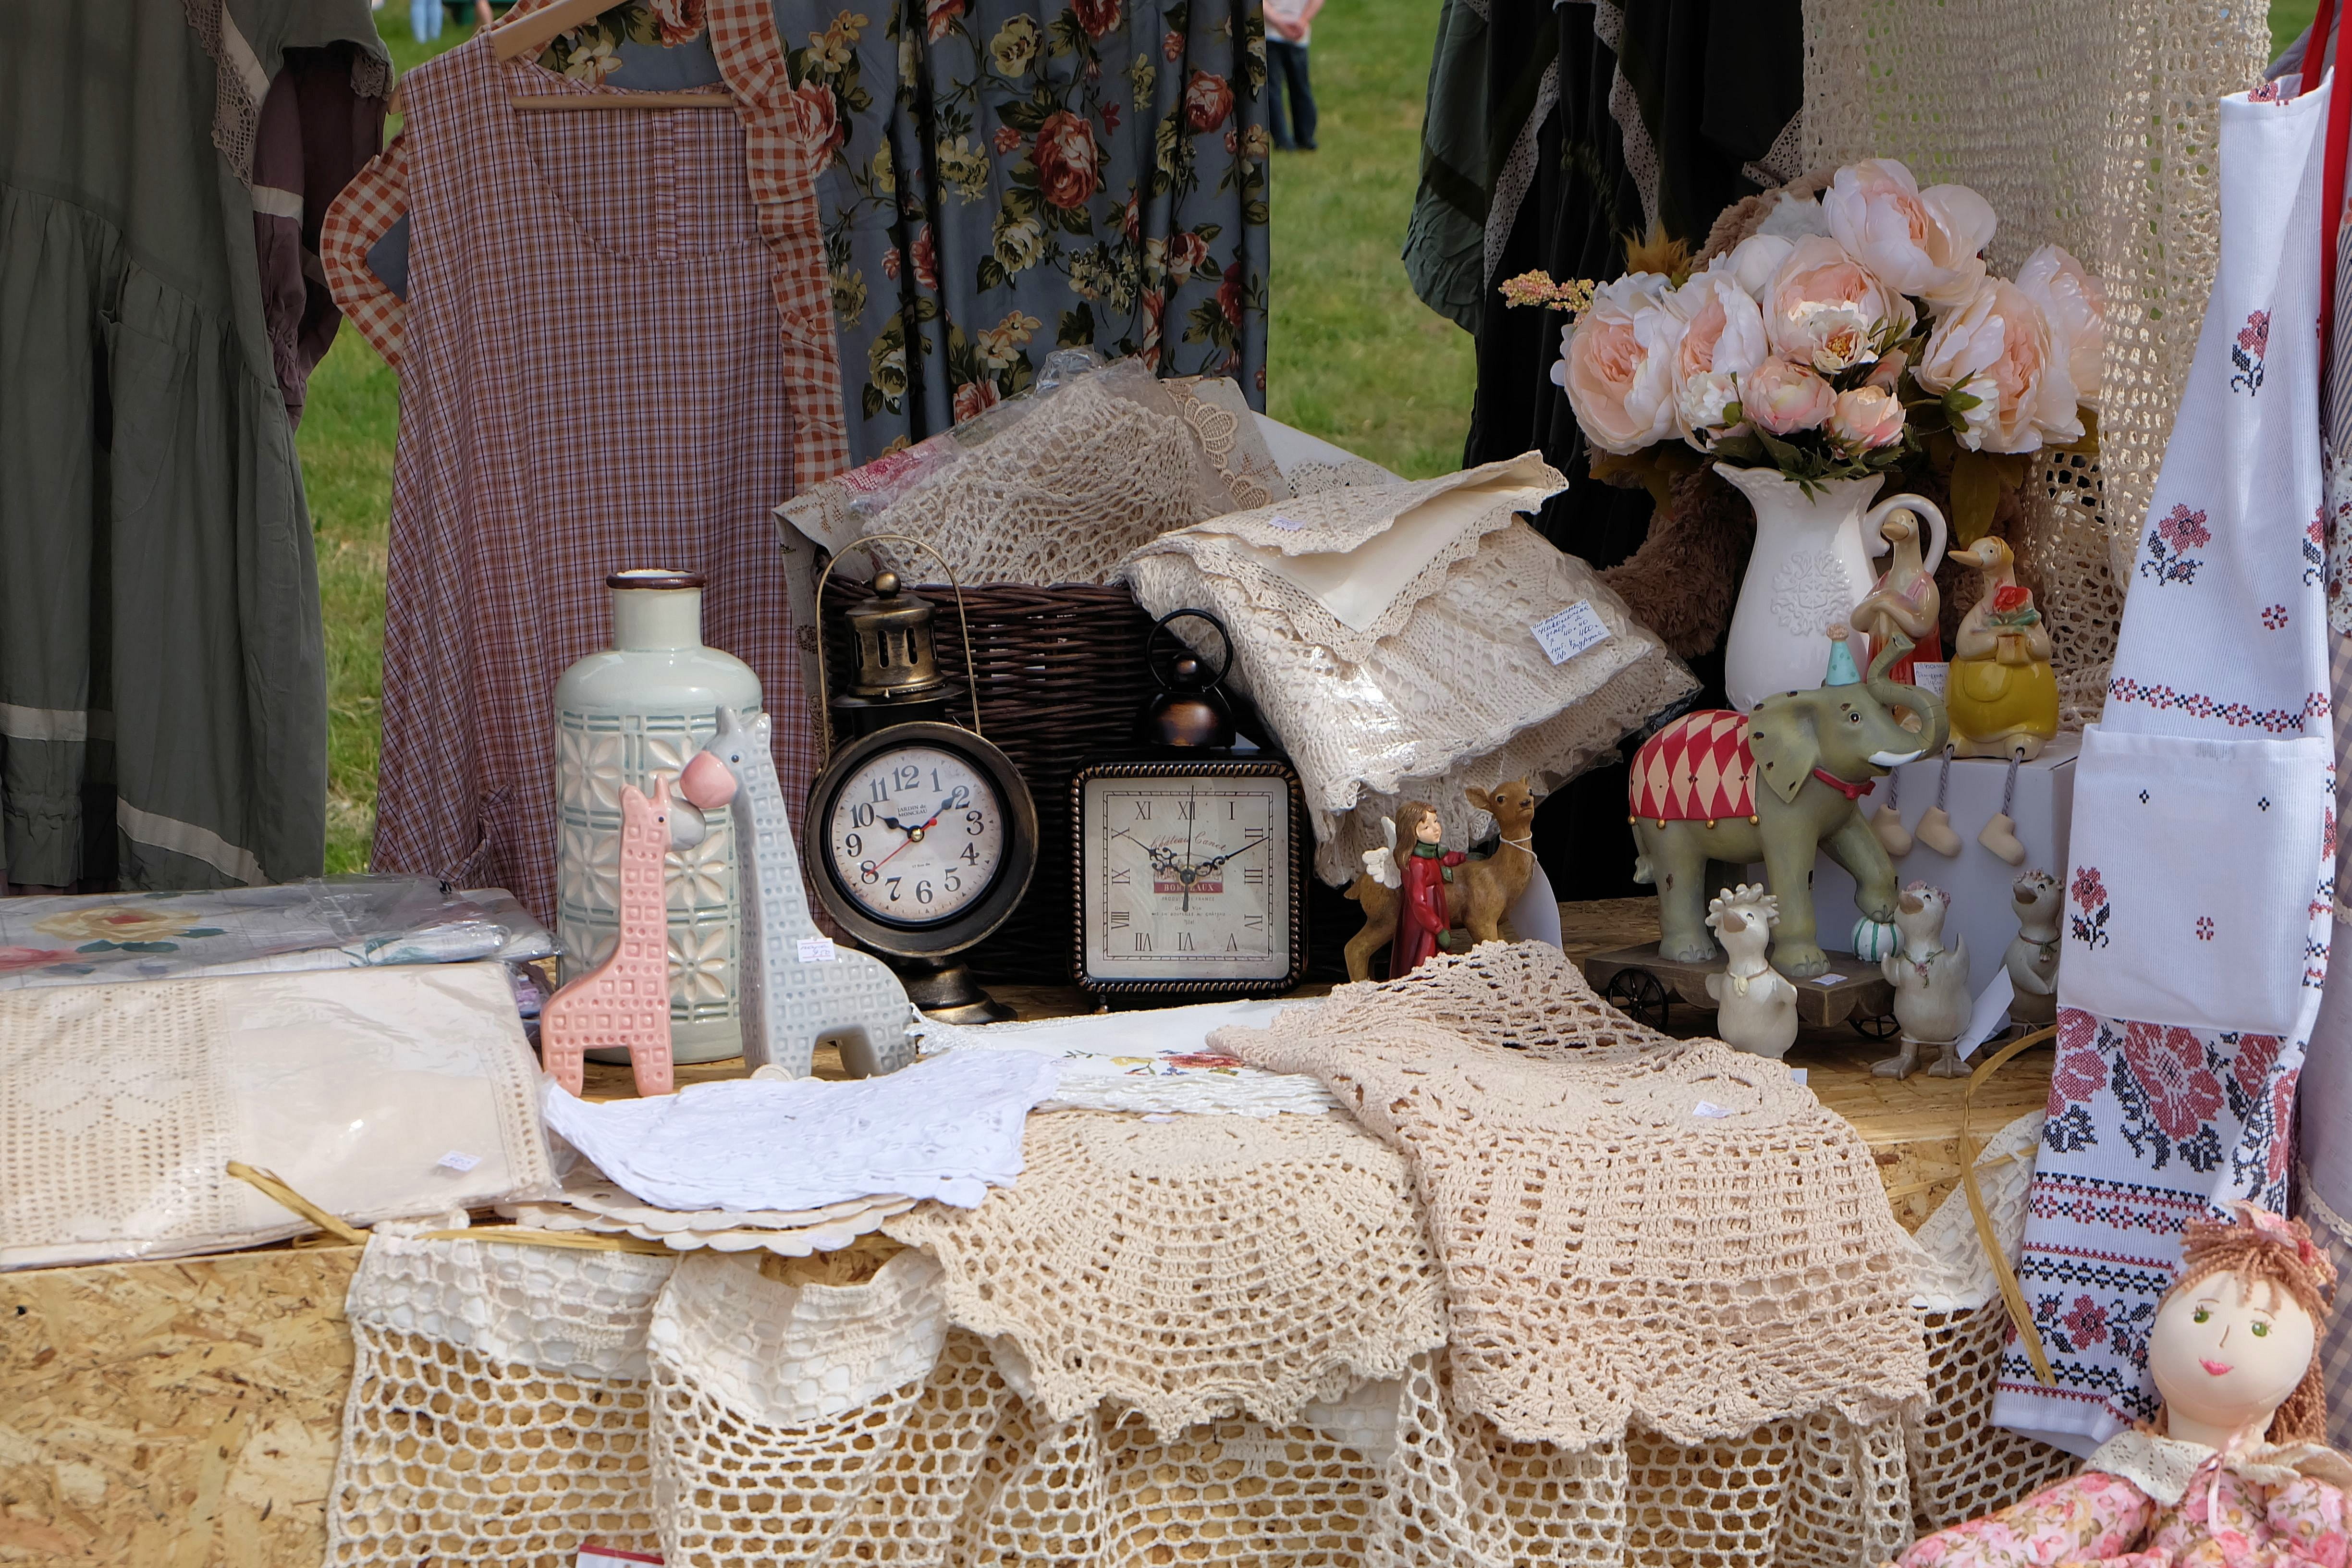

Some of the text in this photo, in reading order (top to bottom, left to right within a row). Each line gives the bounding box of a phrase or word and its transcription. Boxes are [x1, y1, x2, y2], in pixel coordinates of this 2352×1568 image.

[870, 776, 890, 803] 11
[892, 765, 920, 792] 12
[930, 768, 943, 792] 1
[897, 805, 919, 813] JARDIN
[951, 785, 970, 809] 2
[849, 802, 875, 829] 10
[898, 809, 927, 817] MONCEAU
[966, 810, 984, 835] 3
[1135, 801, 1152, 820] XI
[1228, 801, 1236, 820] I
[845, 833, 862, 858] 9
[1111, 827, 1130, 840] X
[1193, 831, 1226, 851] Canet
[960, 842, 980, 866] 4
[860, 860, 879, 884] 8
[944, 867, 961, 893] 5
[885, 876, 902, 902] 7
[916, 880, 933, 904] 6
[1164, 883, 1214, 892] BOREAUX
